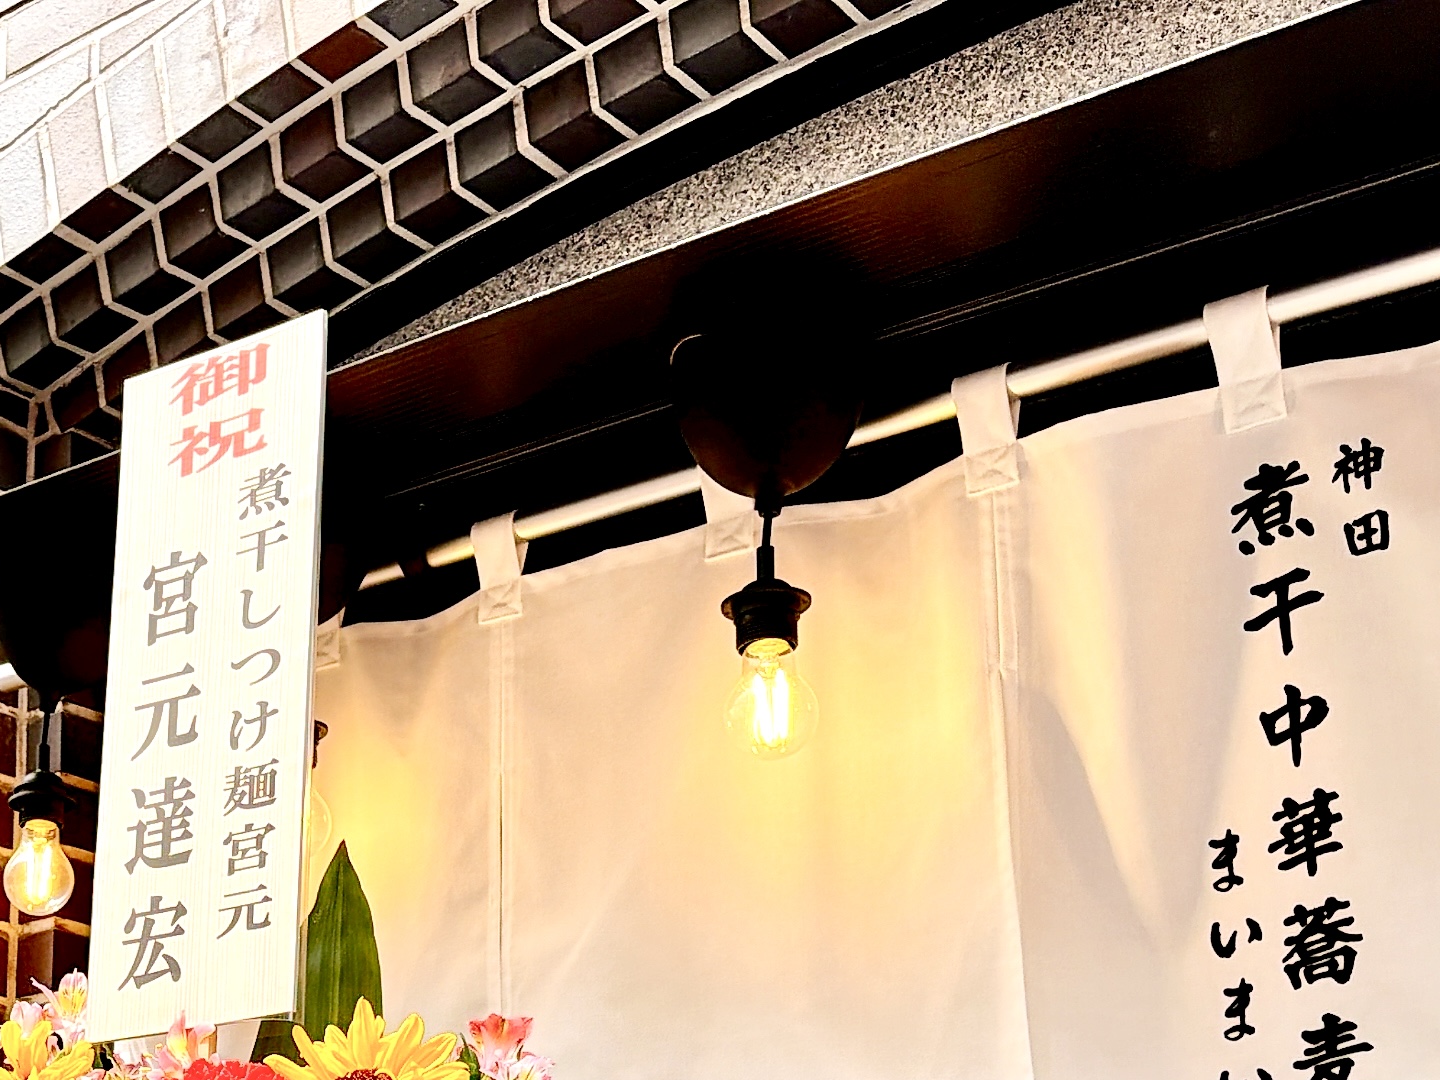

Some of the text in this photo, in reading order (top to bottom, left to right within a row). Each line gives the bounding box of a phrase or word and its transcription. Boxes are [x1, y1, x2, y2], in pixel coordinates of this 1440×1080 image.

[167, 343, 271, 478] 御祝
[1331, 437, 1391, 556] 神田
[118, 551, 208, 991] 宮元達宏
